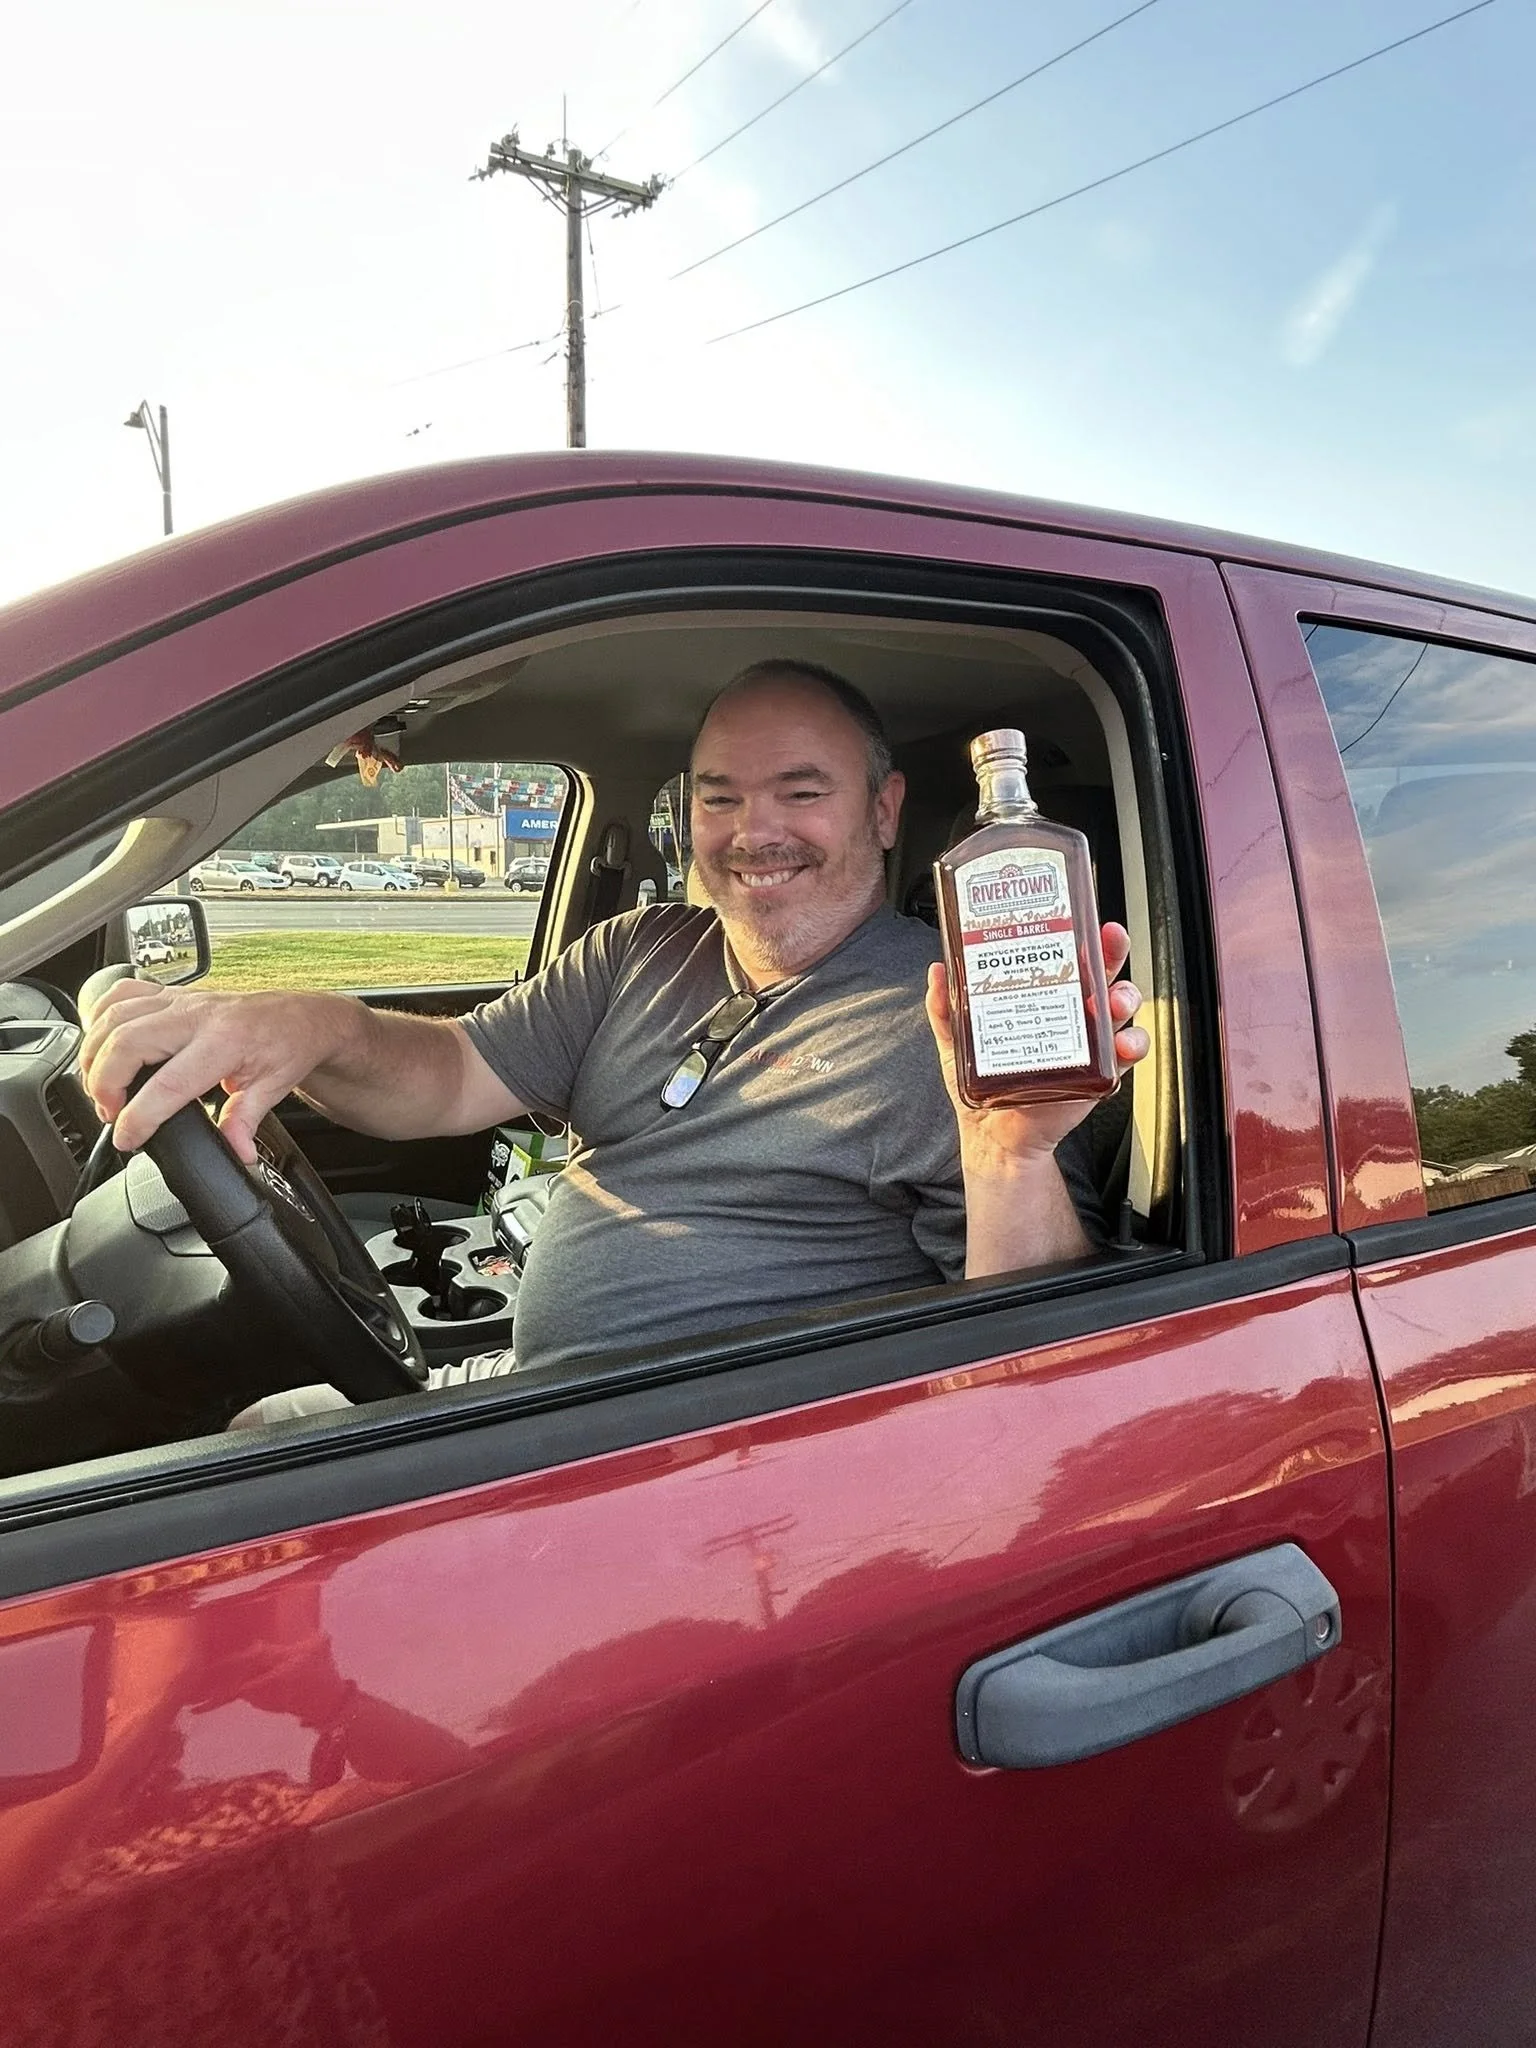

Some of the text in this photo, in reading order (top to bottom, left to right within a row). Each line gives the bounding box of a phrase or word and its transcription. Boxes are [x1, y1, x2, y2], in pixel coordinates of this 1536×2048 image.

[972, 874, 1054, 903] RIVERTOWN
[983, 923, 1051, 940] SINGLE BARREL
[978, 942, 1061, 958] KENTUCKY STRAIGHT
[977, 949, 1064, 970] BOURBON
[993, 989, 1058, 1002] CARGO MANIFEST
[1005, 1020, 1014, 1030] 8
[1037, 1055, 1072, 1063] KENTUCKY
